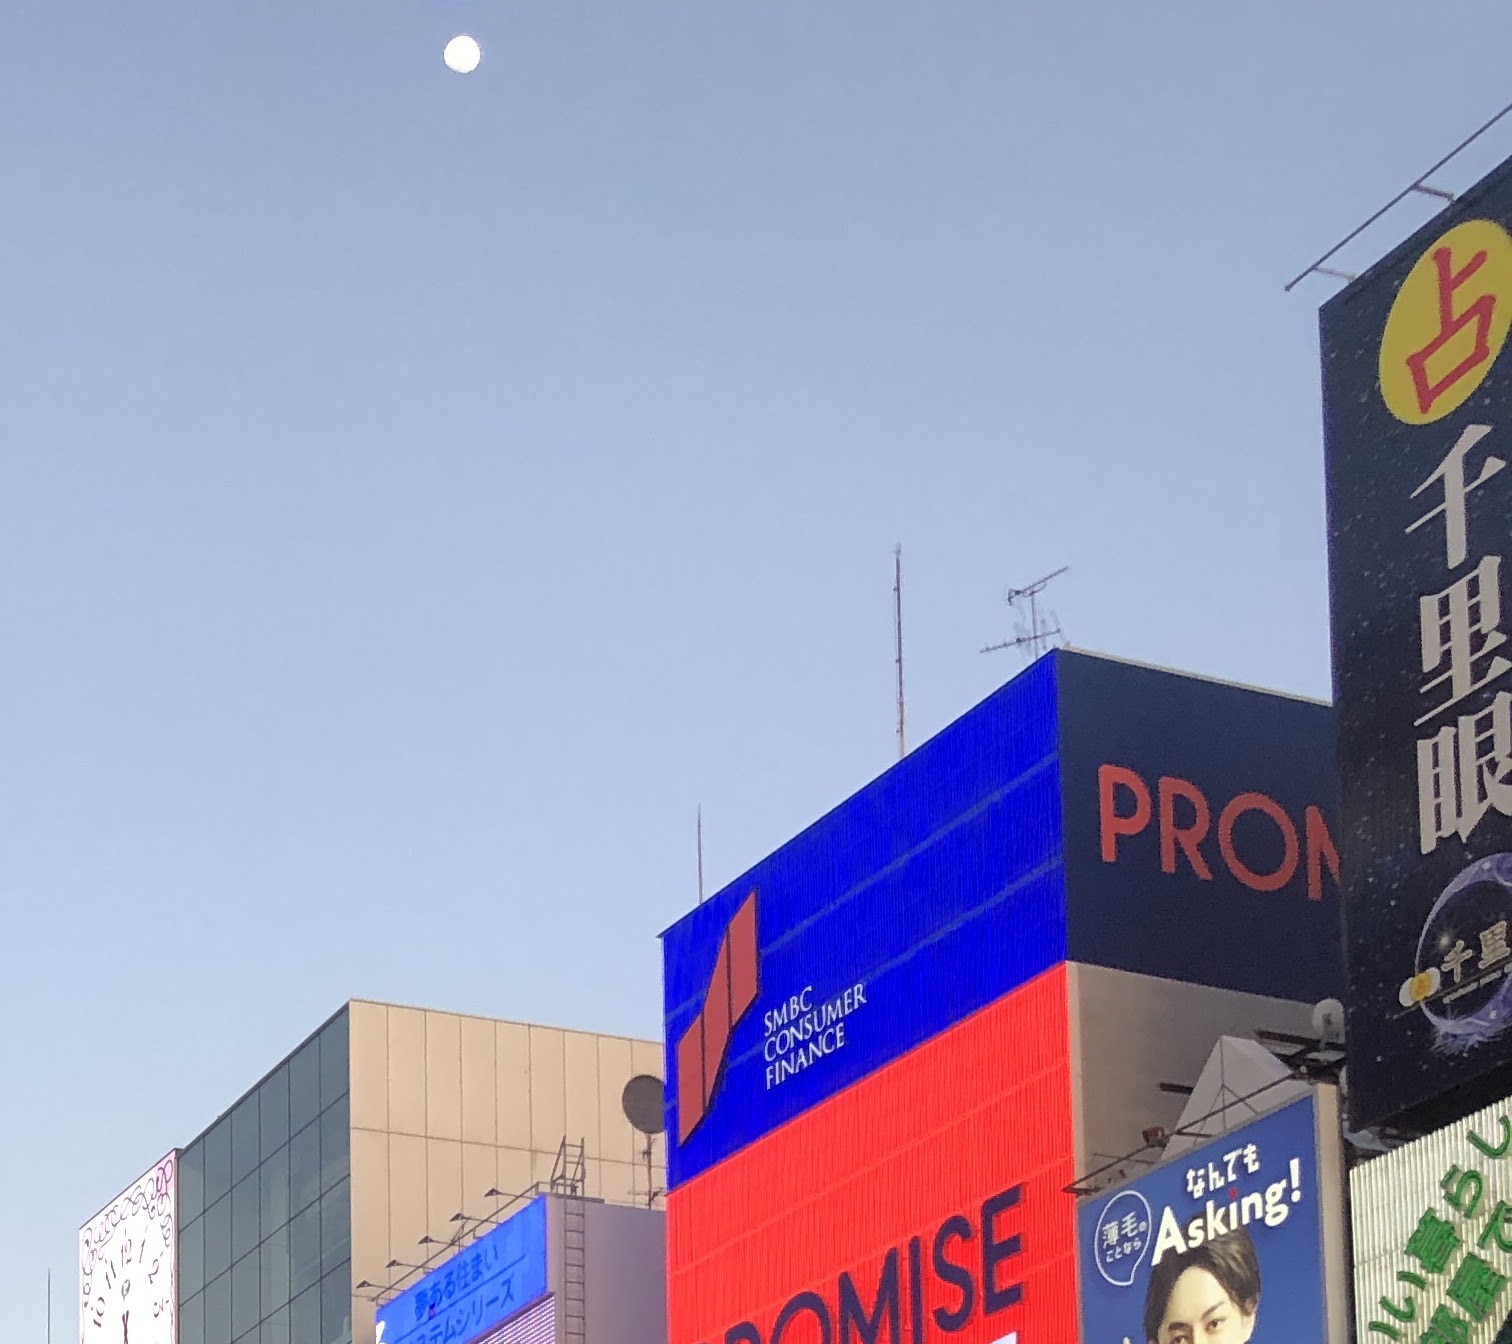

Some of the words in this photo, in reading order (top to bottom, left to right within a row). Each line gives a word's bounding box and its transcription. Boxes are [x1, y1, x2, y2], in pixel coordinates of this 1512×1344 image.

[1408, 245, 1496, 414] 占
[1404, 423, 1512, 855] 千里眼
[764, 985, 813, 1032] SMBC
[764, 983, 868, 1063] CONSUMER
[765, 1022, 846, 1090] FINANCE
[1186, 1142, 1261, 1200] なんでも
[1151, 1157, 1302, 1267] Asking!
[1105, 1237, 1142, 1263] ことなら
